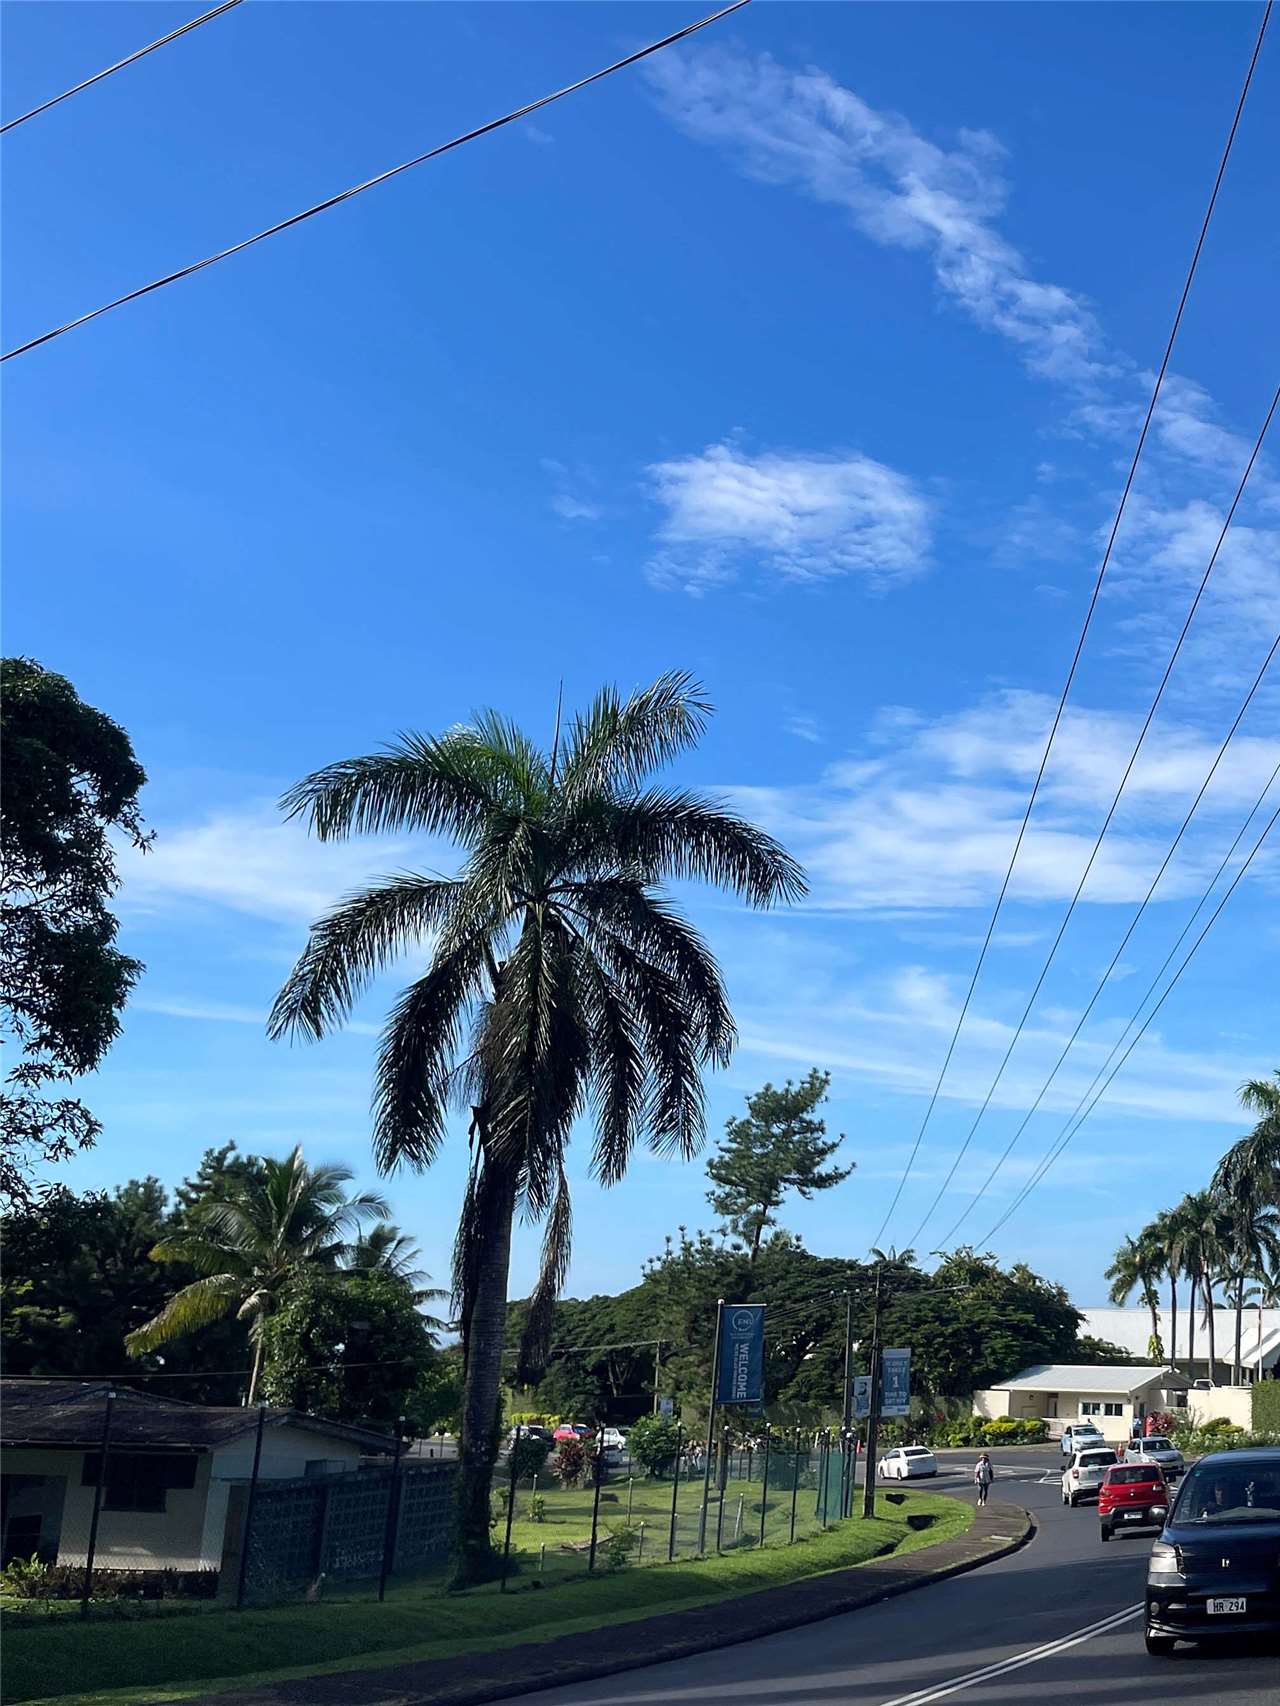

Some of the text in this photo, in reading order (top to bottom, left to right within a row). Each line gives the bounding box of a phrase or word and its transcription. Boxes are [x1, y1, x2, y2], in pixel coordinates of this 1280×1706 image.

[736, 1342, 750, 1399] WELCOME
[1213, 1600, 1245, 1613] HR 294
